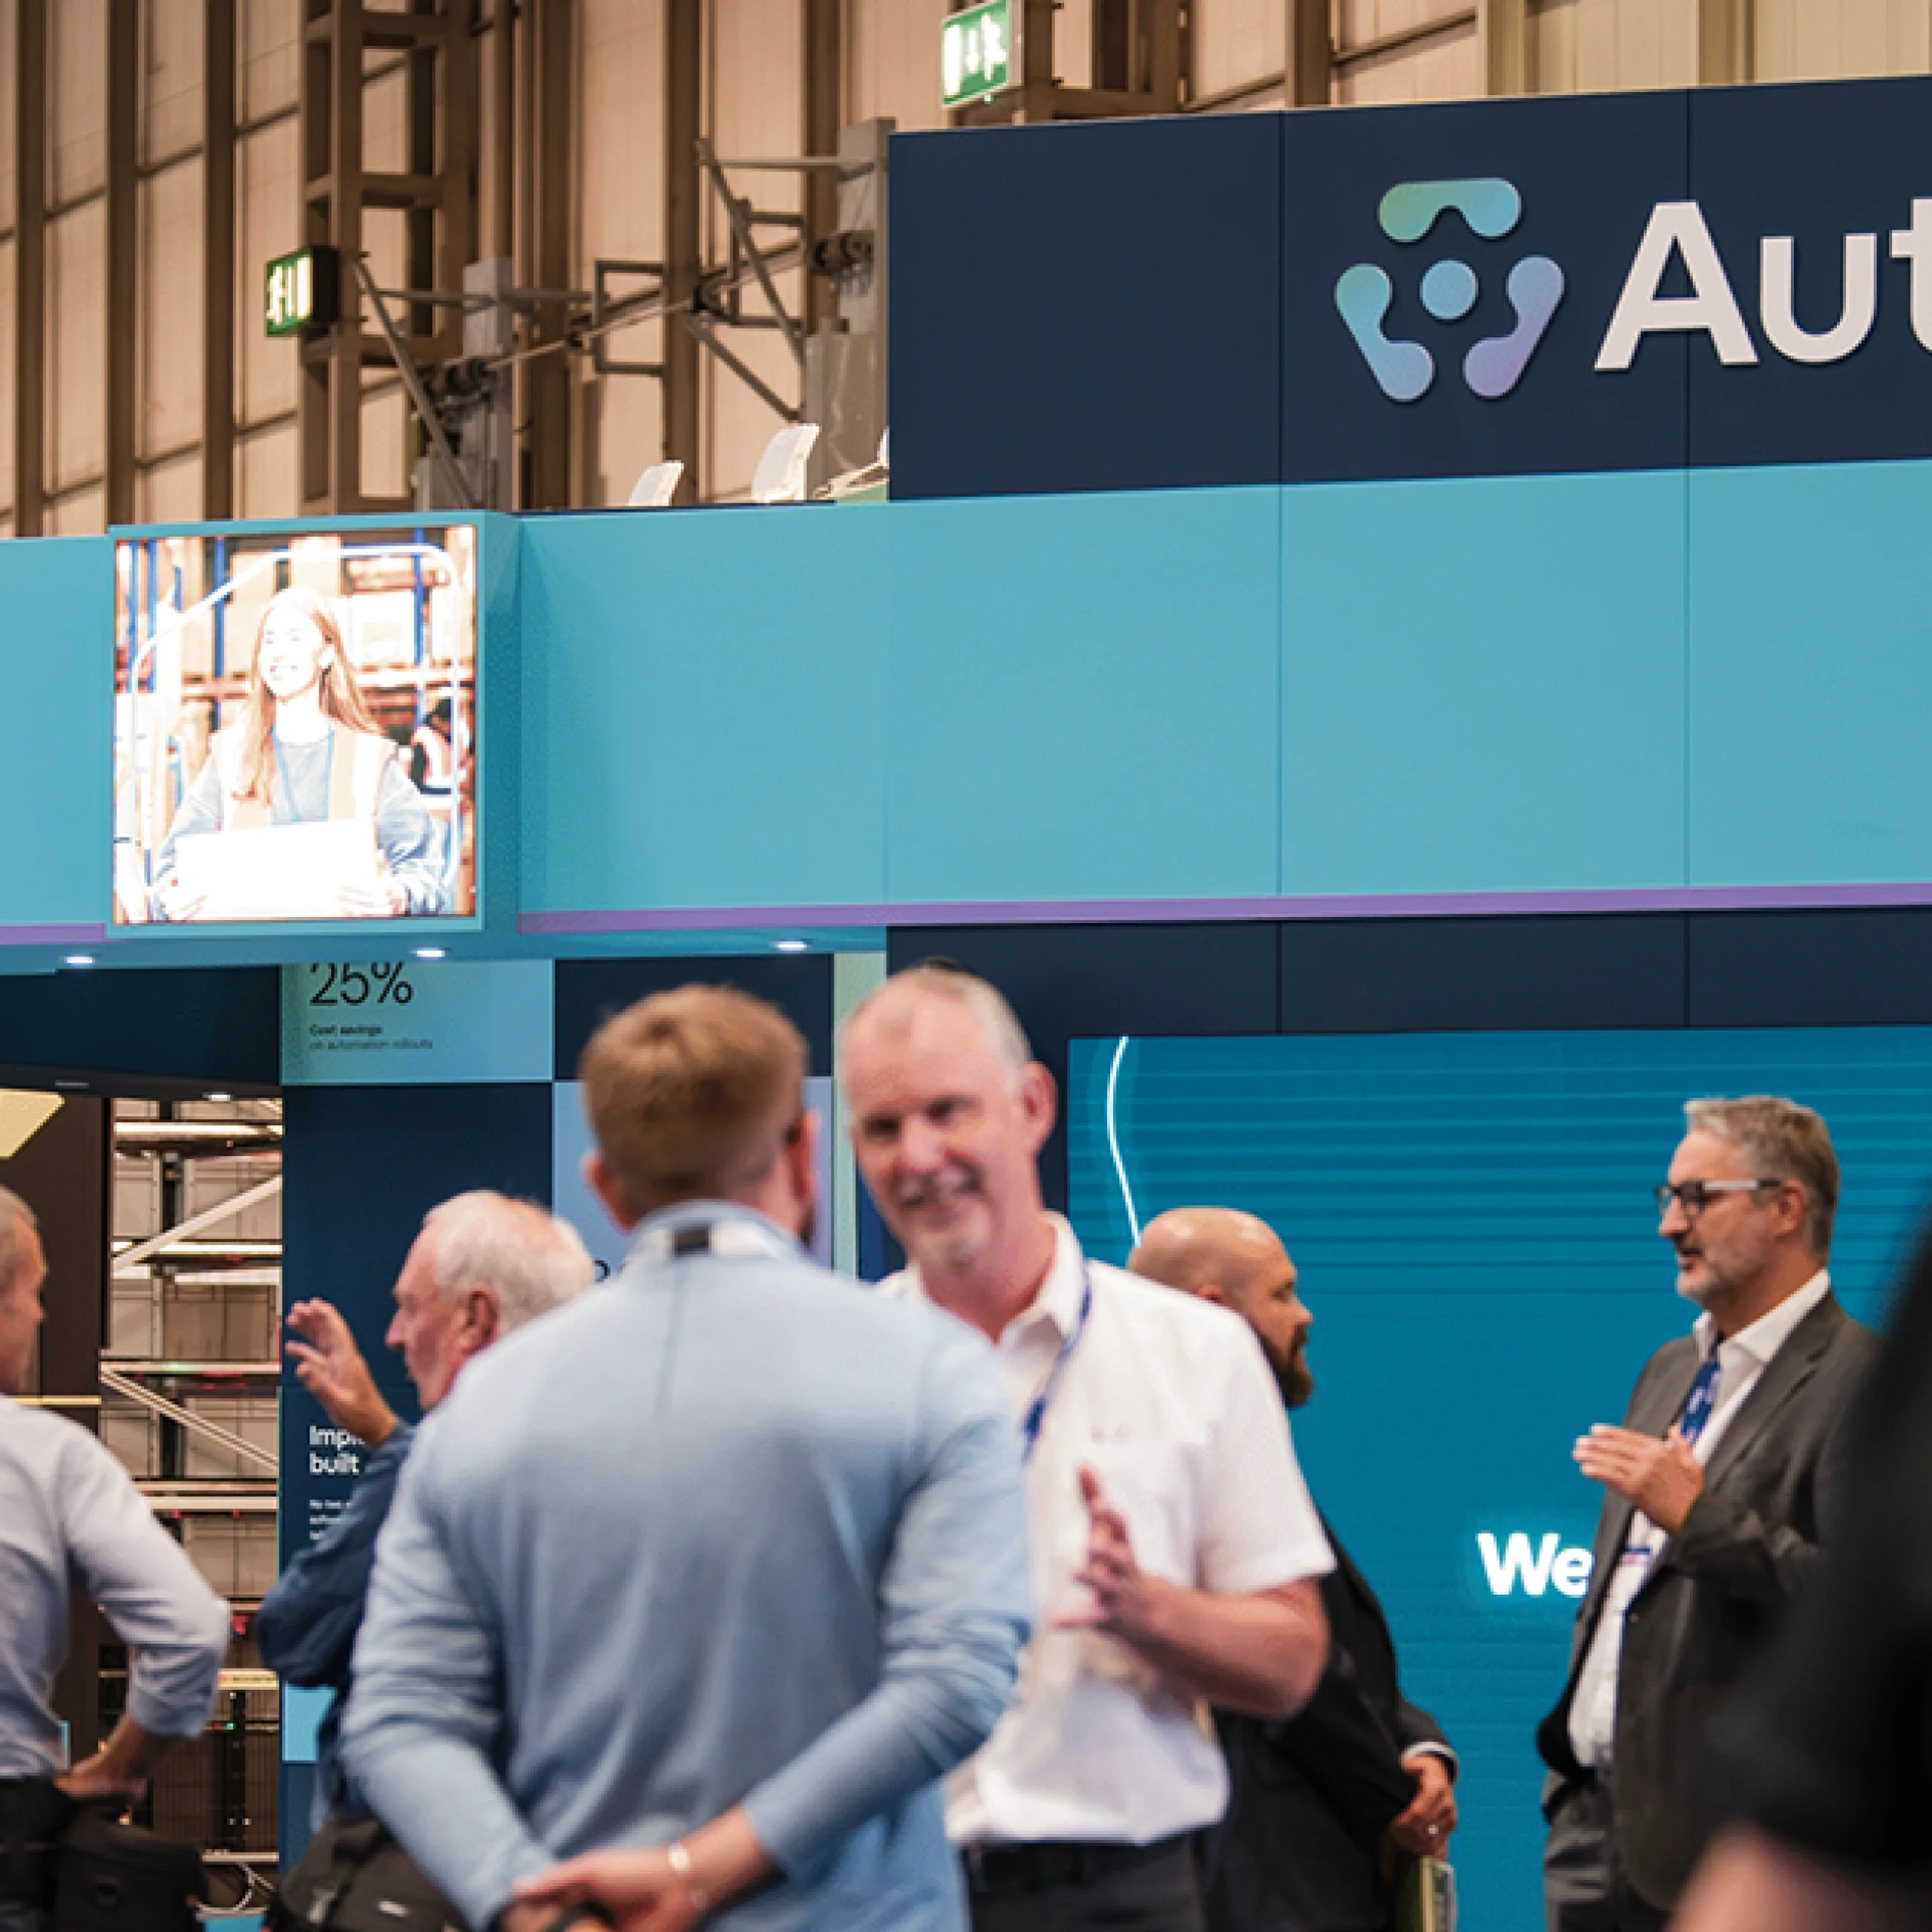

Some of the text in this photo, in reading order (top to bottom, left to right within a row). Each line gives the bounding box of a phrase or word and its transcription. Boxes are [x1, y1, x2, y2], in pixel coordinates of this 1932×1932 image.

[309, 961, 414, 1005] 25%
[309, 1451, 359, 1475] built
[1476, 1531, 1593, 1598] We
